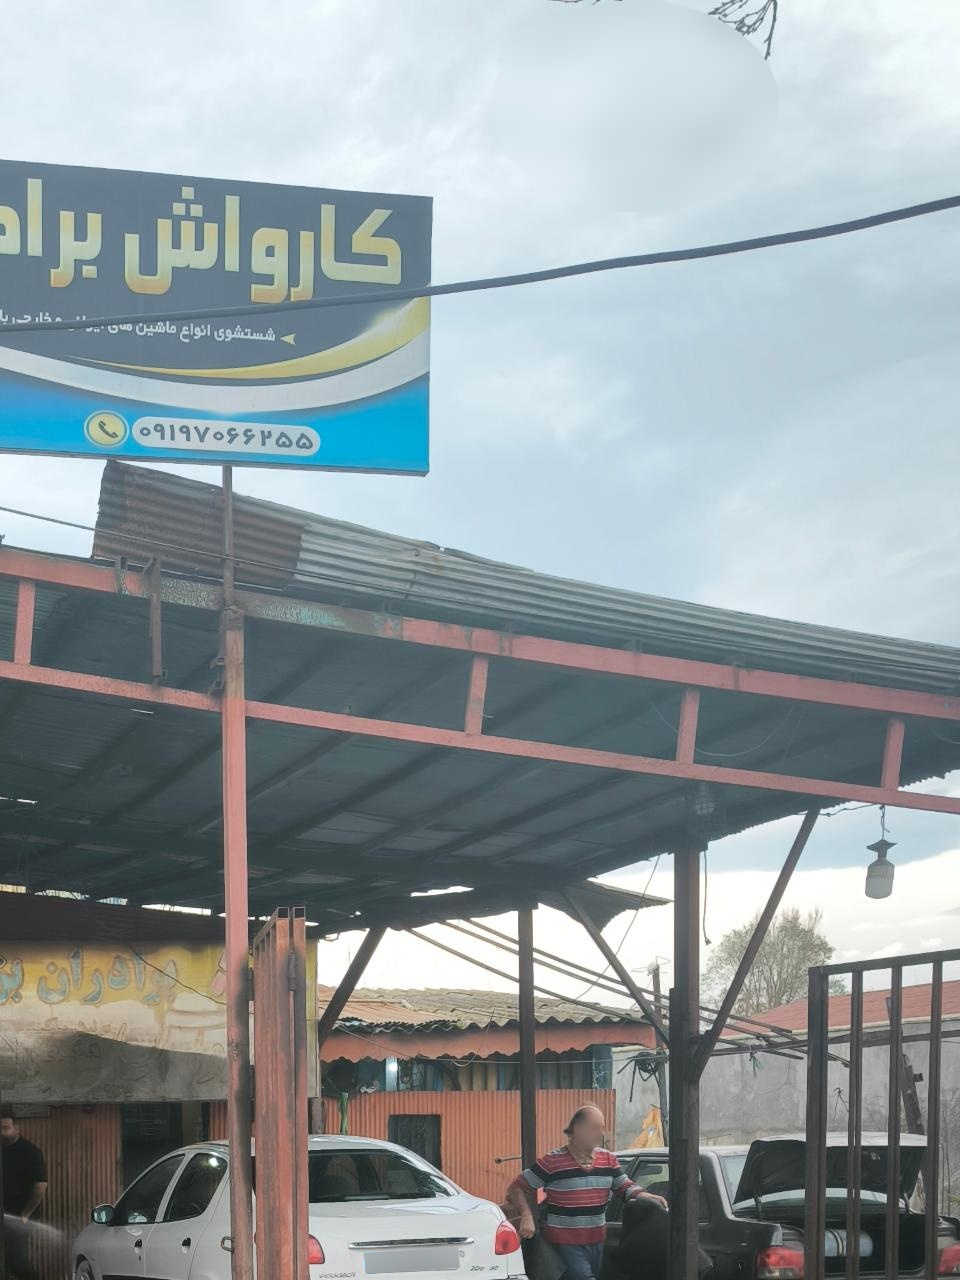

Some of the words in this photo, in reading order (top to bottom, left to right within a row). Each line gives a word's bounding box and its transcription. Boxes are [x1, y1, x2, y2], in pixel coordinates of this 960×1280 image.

[124, 186, 402, 304] کارواش
[135, 321, 177, 336] ماشین
[179, 323, 211, 342] انواع
[214, 325, 276, 342] شستشوی
[140, 424, 313, 449] ۰۹۱۹۷۰۶۶۲۵۵
